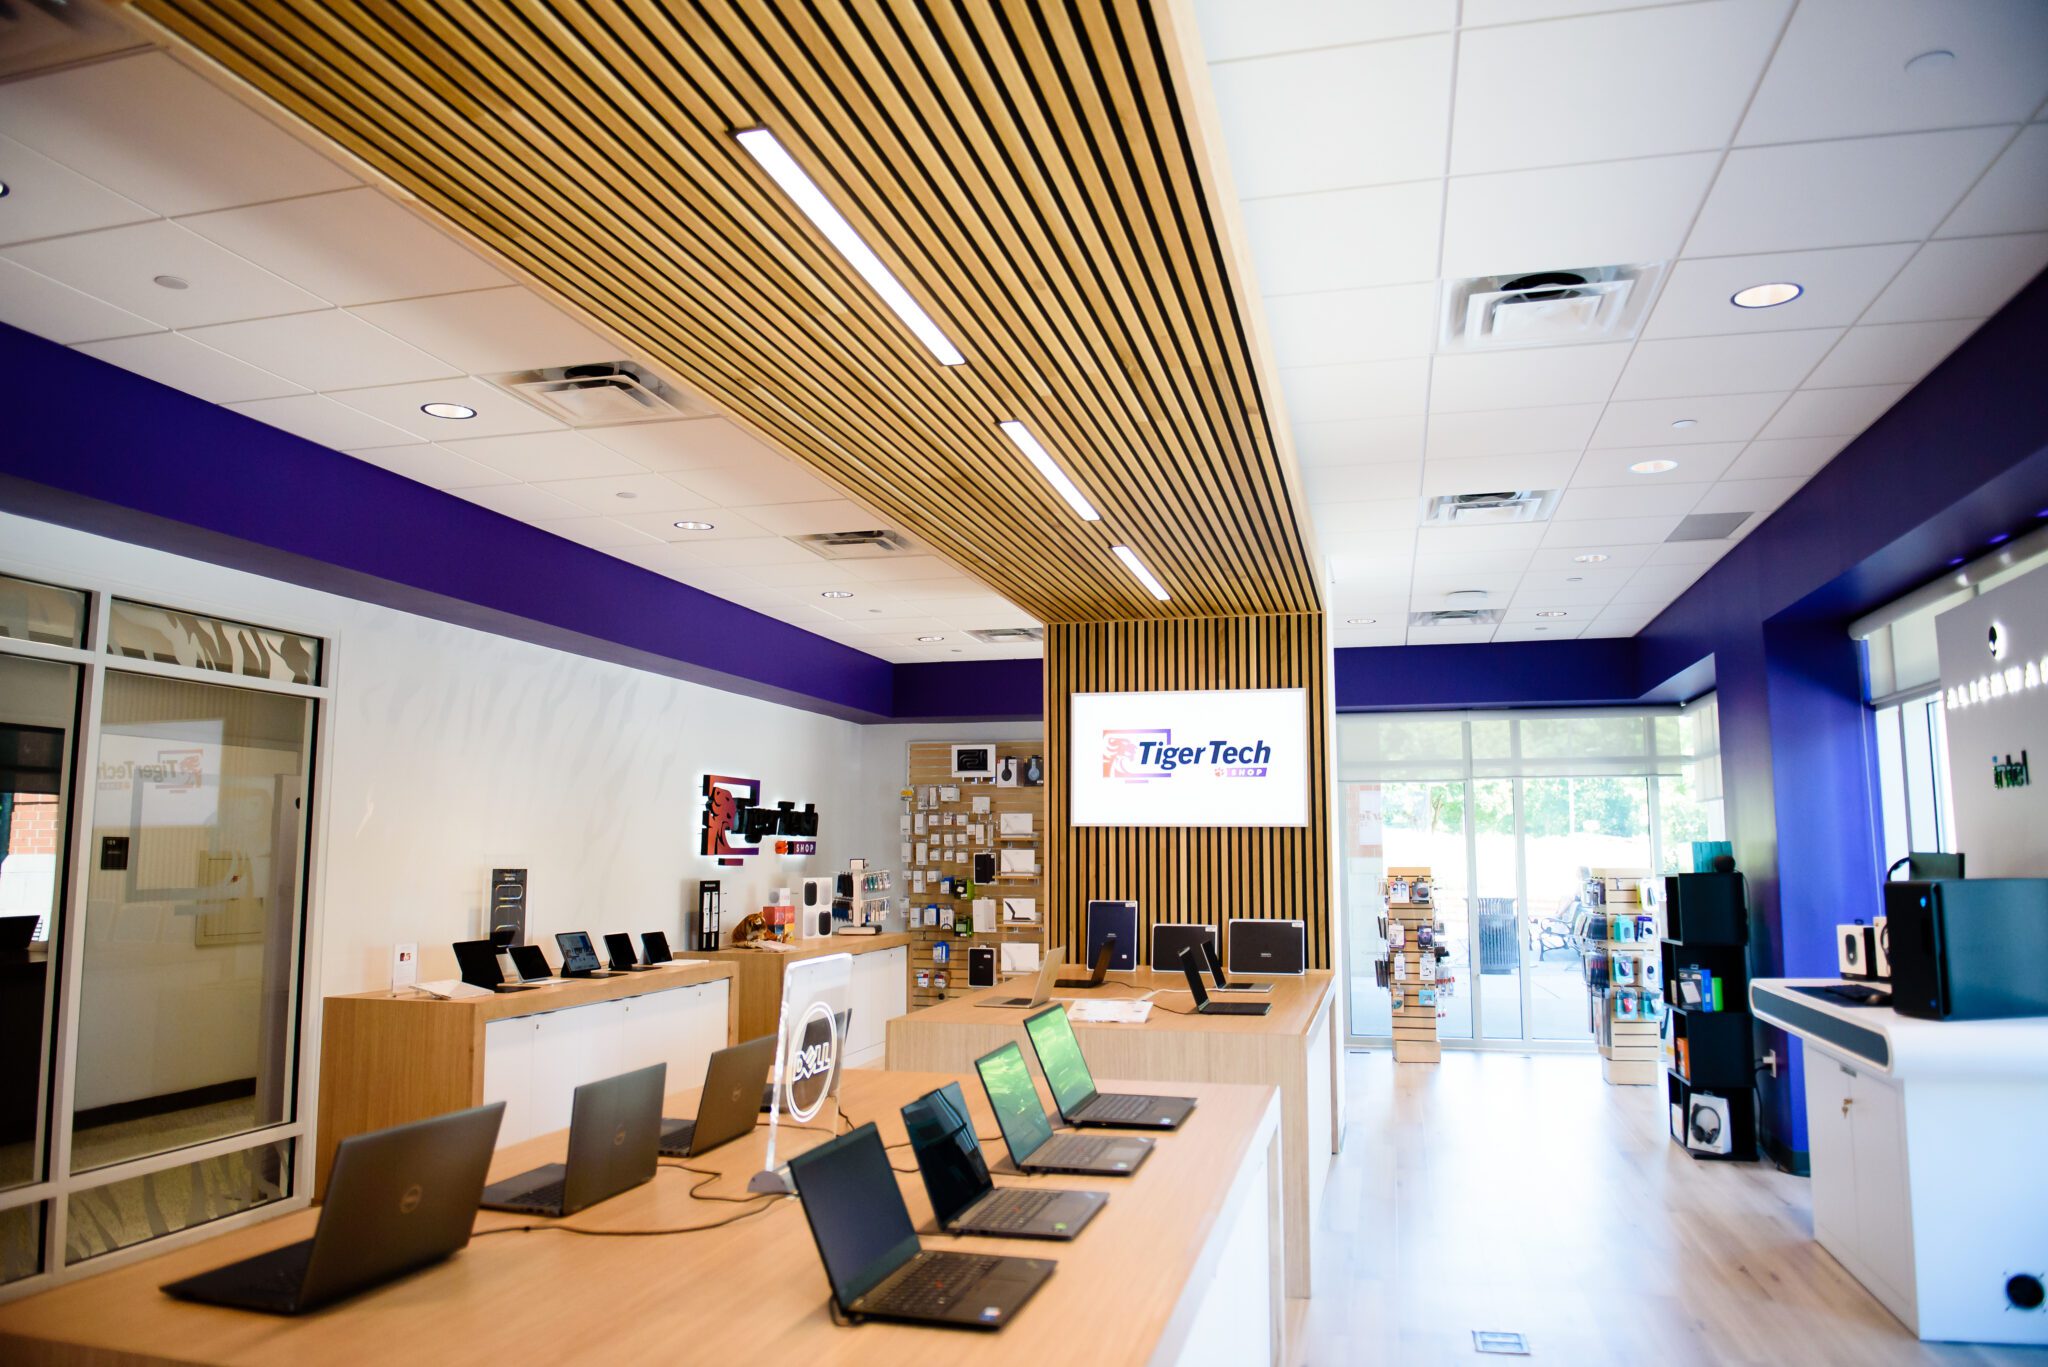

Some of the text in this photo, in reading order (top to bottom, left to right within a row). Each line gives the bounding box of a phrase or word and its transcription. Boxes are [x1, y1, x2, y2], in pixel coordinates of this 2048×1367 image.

[1230, 768, 1263, 777] SHOP
[1992, 749, 2030, 789] intel
[795, 843, 815, 853] SHOP
[792, 1041, 832, 1082] DELL
